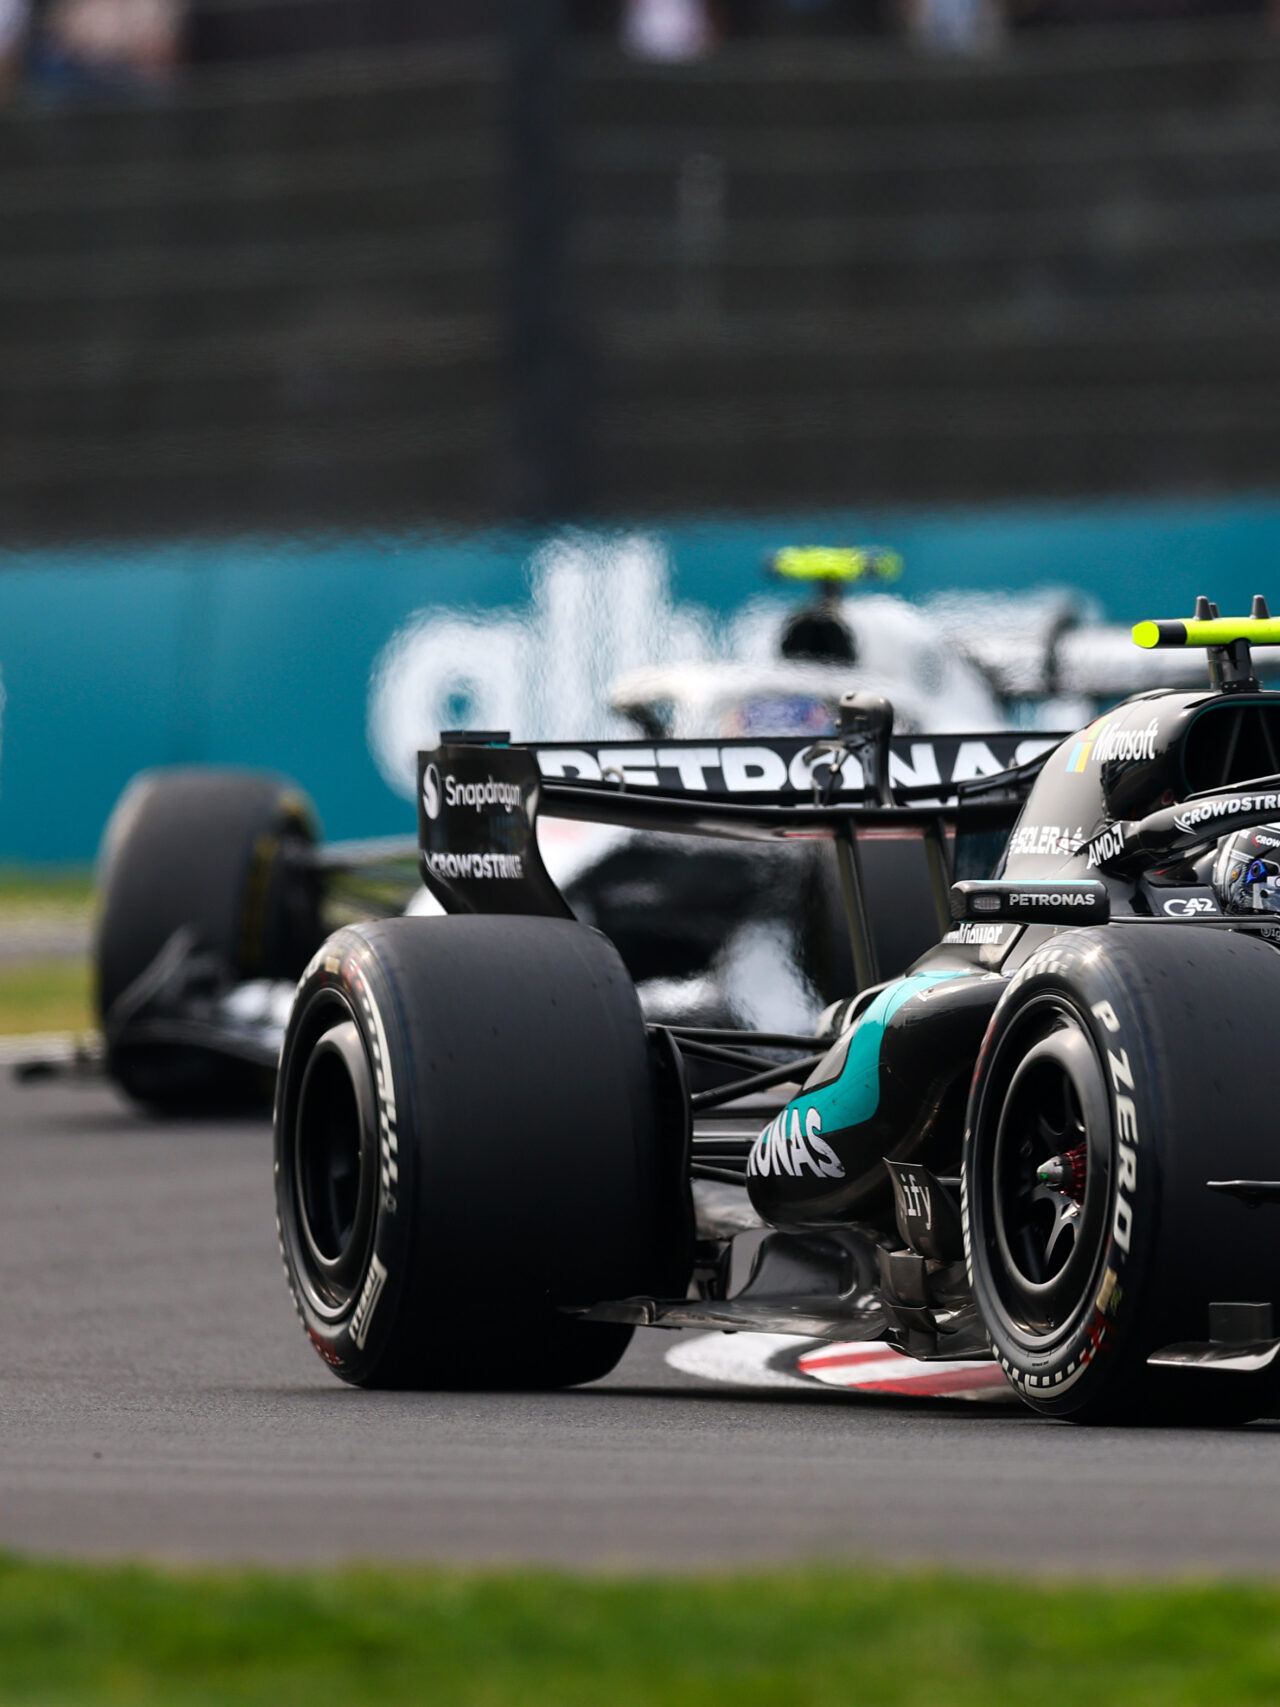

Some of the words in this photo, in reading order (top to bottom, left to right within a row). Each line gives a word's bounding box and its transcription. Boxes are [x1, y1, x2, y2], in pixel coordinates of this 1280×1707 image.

[1092, 717, 1158, 761] Microsoft
[446, 774, 520, 813] Snapdragon
[431, 853, 524, 879] CROWDSTRIKE
[1086, 830, 1116, 869] AMD
[1008, 893, 1096, 906] PETRONAS
[1164, 898, 1217, 917] G42
[1091, 999, 1121, 1034] P
[1106, 1046, 1140, 1256] ZERO
